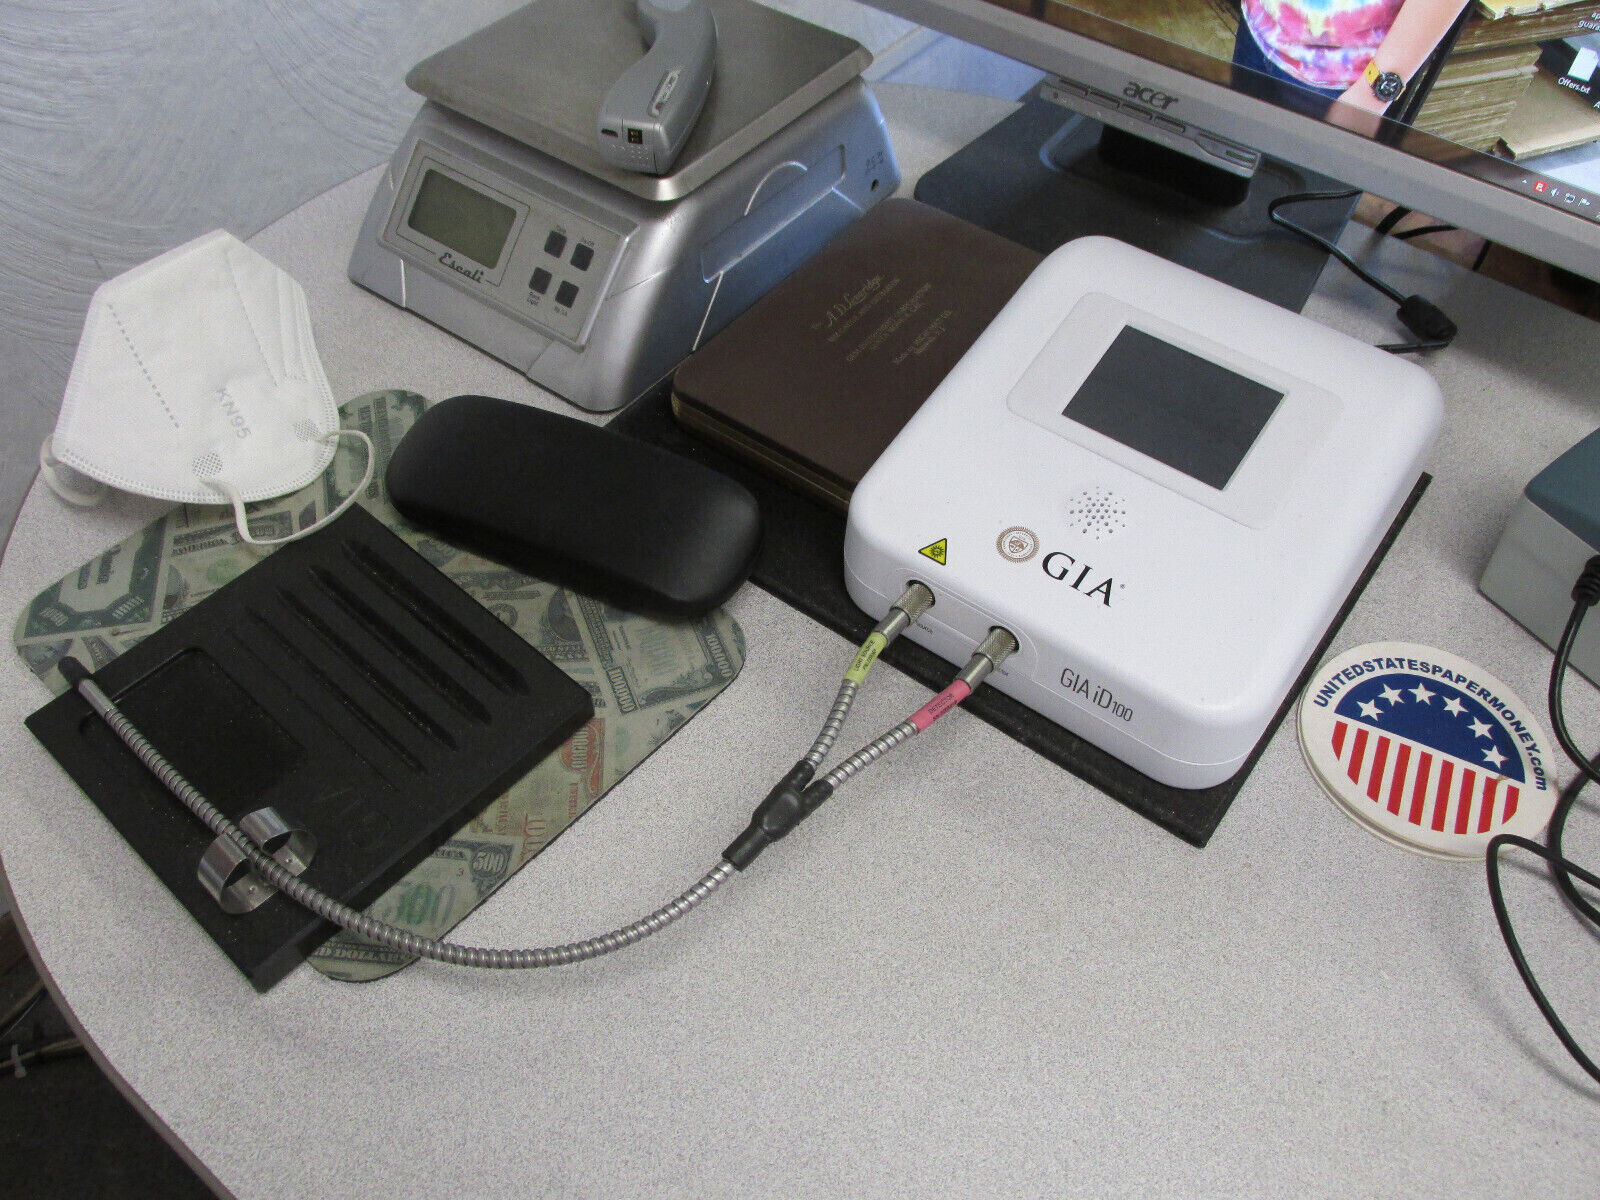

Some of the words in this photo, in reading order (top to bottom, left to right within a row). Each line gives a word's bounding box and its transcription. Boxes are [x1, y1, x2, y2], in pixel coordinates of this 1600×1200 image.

[1123, 81, 1179, 109] acer
[1557, 77, 1591, 95] Offers.txt
[439, 252, 484, 283] Escali
[216, 388, 251, 439] KN95
[1042, 551, 1113, 608] GIA
[1060, 668, 1090, 700] GIA
[1313, 657, 1547, 791] UNITEDSTATESPAPERMONEY.com
